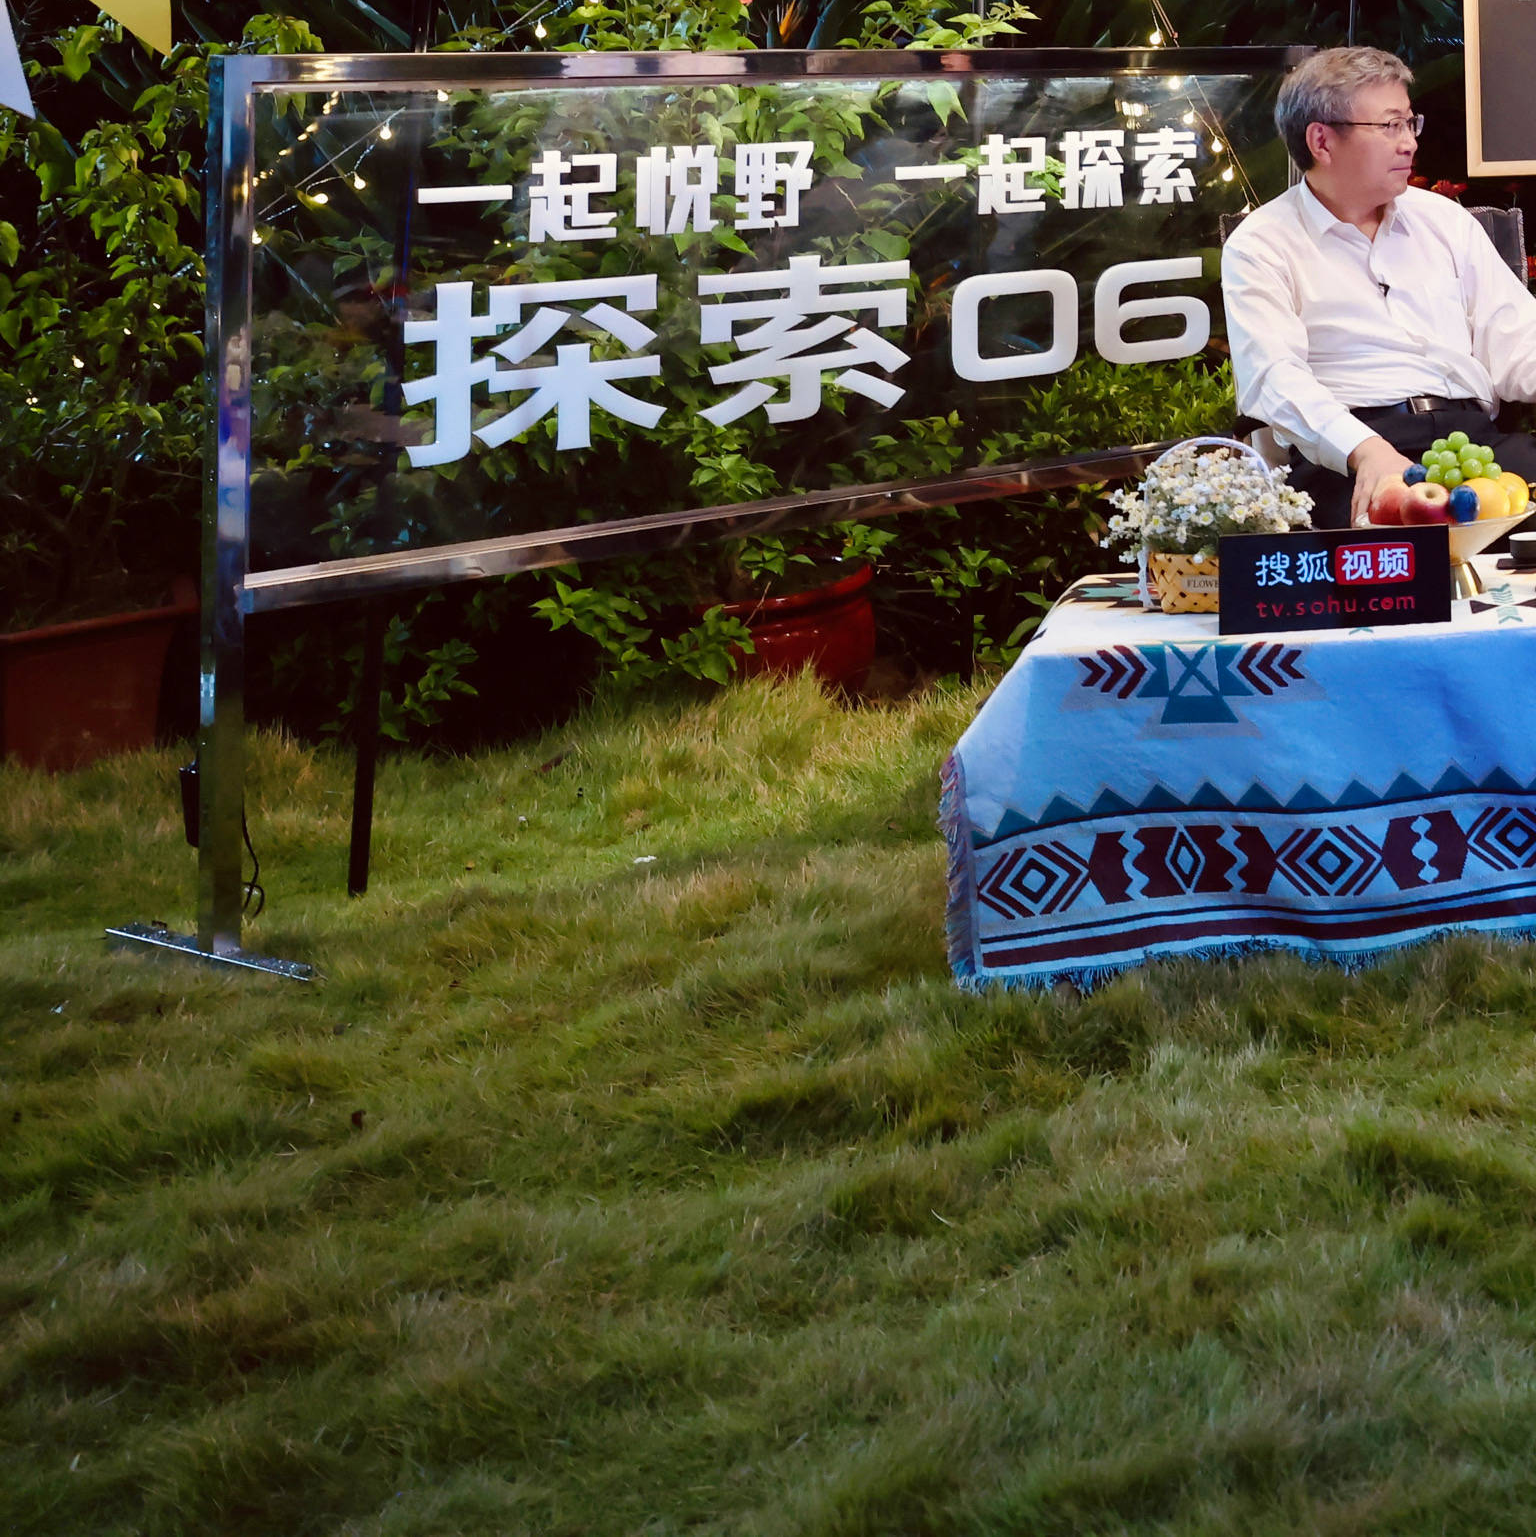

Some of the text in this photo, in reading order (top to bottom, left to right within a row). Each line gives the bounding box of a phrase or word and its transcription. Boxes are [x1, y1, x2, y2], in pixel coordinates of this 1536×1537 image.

[418, 127, 1197, 243] 一起悦野 一起探索
[403, 255, 1211, 469] 探索06
[1255, 546, 1411, 587] 搜狐视频
[1256, 594, 1415, 619] tv.sohu.com
